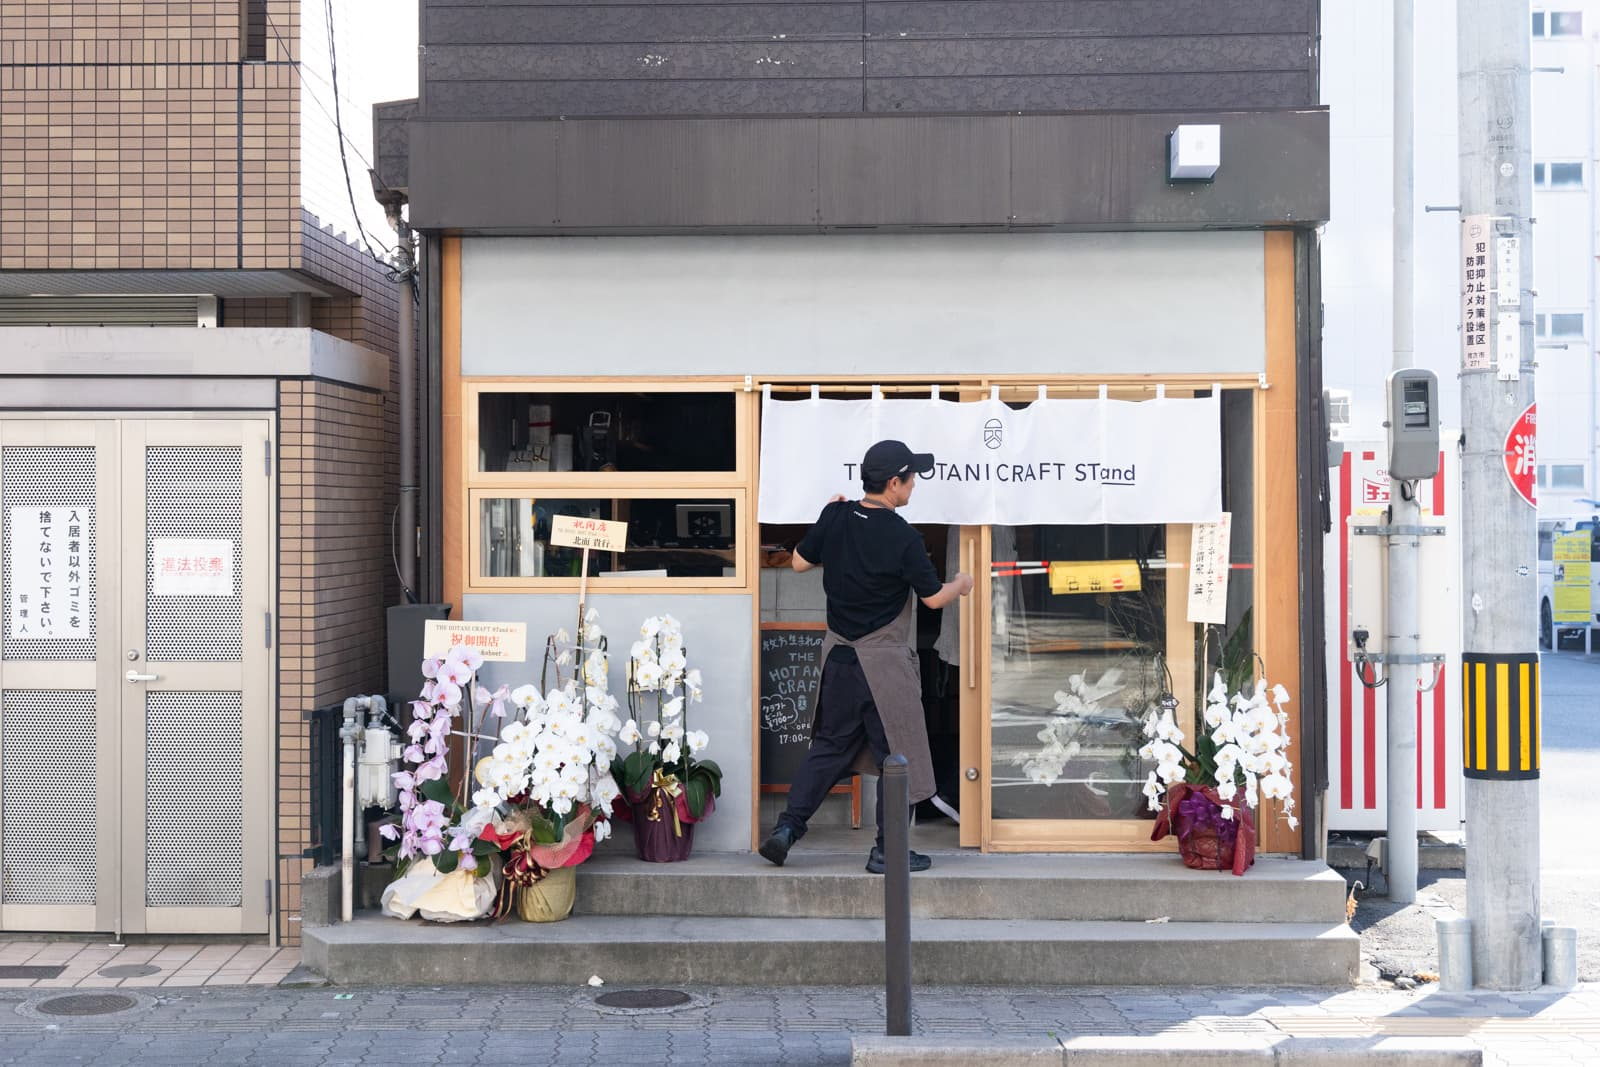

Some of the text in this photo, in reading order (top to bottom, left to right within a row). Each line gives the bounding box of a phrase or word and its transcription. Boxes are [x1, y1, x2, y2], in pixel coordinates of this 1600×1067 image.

[1465, 256, 1475, 346] 防犯カメラ設置
[1475, 242, 1486, 345] 犯罪抑止対策地区
[918, 462, 1136, 486] OTANI CRAFT STand
[39, 511, 53, 635] 捨てないで下さい。
[68, 510, 81, 628] 入居者以外ゴミを
[19, 594, 29, 634] 管理人
[769, 666, 821, 682] HOTAN
[789, 653, 815, 662] THE
[779, 680, 817, 694] CRAF
